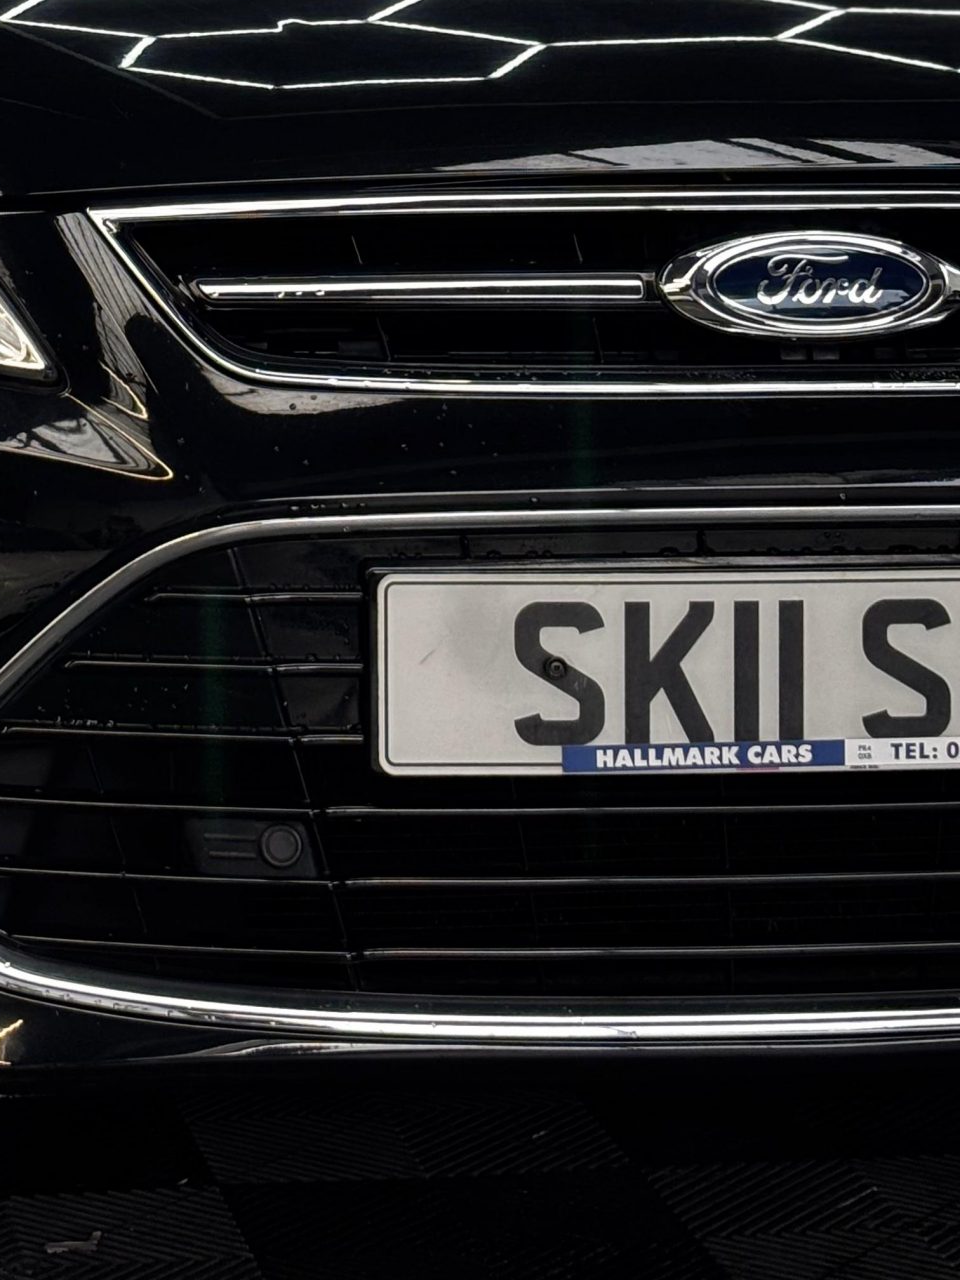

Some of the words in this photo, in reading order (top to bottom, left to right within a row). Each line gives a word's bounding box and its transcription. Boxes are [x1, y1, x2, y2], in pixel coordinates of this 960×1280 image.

[757, 254, 883, 305] Ford
[862, 598, 952, 738] S
[595, 746, 740, 768] HALLMARK
[747, 744, 813, 764] CARS
[890, 742, 938, 759] TEL:
[946, 741, 960, 759] 0
